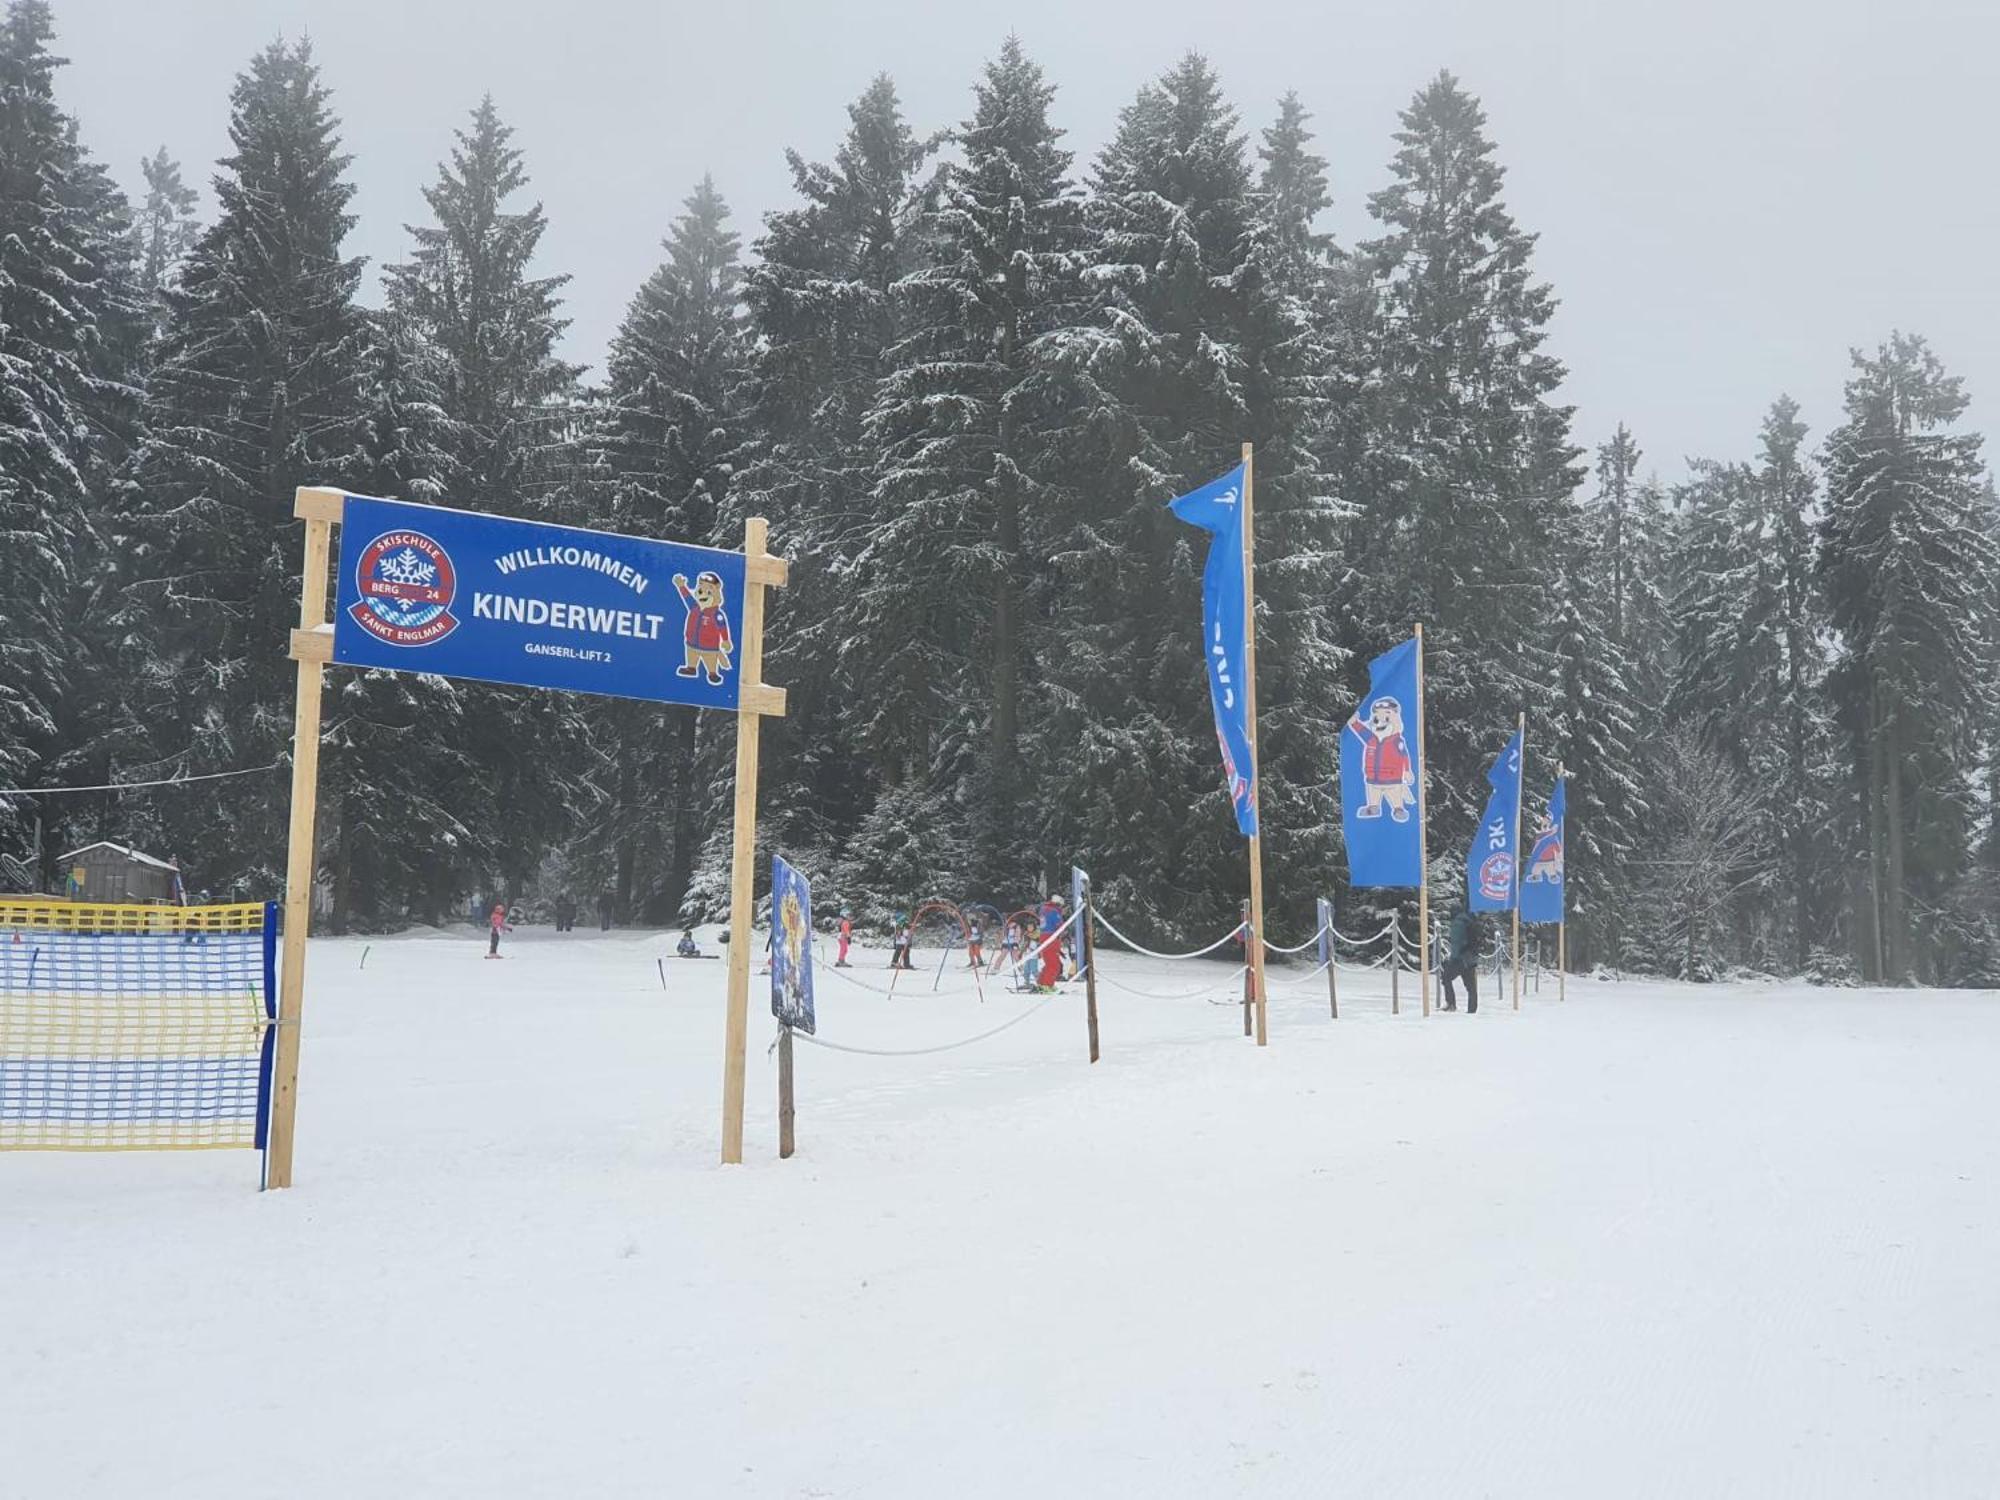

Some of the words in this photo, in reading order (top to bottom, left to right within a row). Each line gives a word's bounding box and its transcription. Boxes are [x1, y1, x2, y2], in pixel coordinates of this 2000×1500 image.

[376, 535, 440, 559] SKISCHULE
[493, 546, 649, 595] WILLKOMMEN
[371, 582, 400, 595] BERG
[426, 590, 440, 600] 24
[361, 612, 394, 637] SANKT
[397, 622, 446, 641] ENGLMAR
[472, 592, 665, 640] KINDERWELT
[524, 643, 602, 663] GANSERL-LIFT
[603, 652, 612, 663] 2
